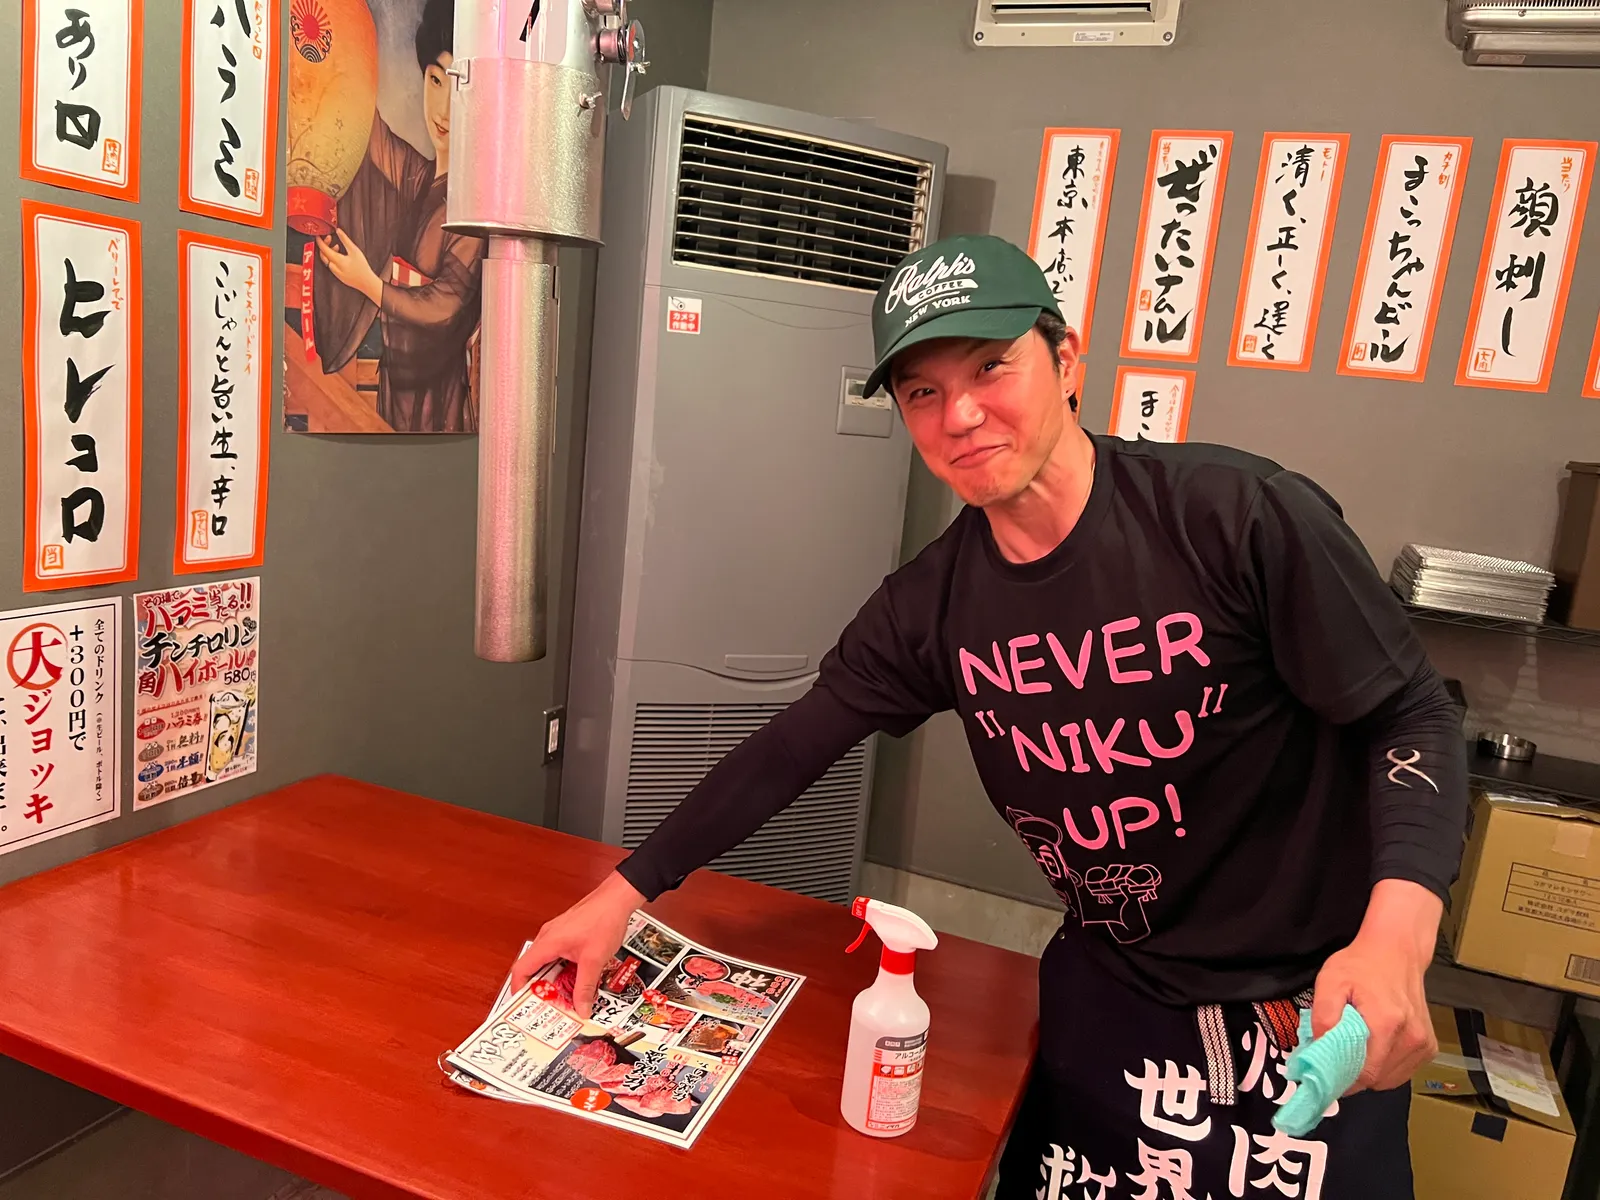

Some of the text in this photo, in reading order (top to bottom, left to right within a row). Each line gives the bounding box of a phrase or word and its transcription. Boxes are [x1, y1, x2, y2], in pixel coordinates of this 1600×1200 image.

[1143, 144, 1218, 343] ぜったいナムル
[302, 249, 314, 351] アサヒビール
[884, 252, 976, 315] Ralph's
[904, 294, 971, 329] NEW YORK
[918, 279, 964, 300] COFFEE
[94, 618, 105, 704] 全てのドリンク
[958, 611, 1211, 696] NEVER
[1062, 783, 1187, 850] UP!
[730, 970, 771, 991] 神
